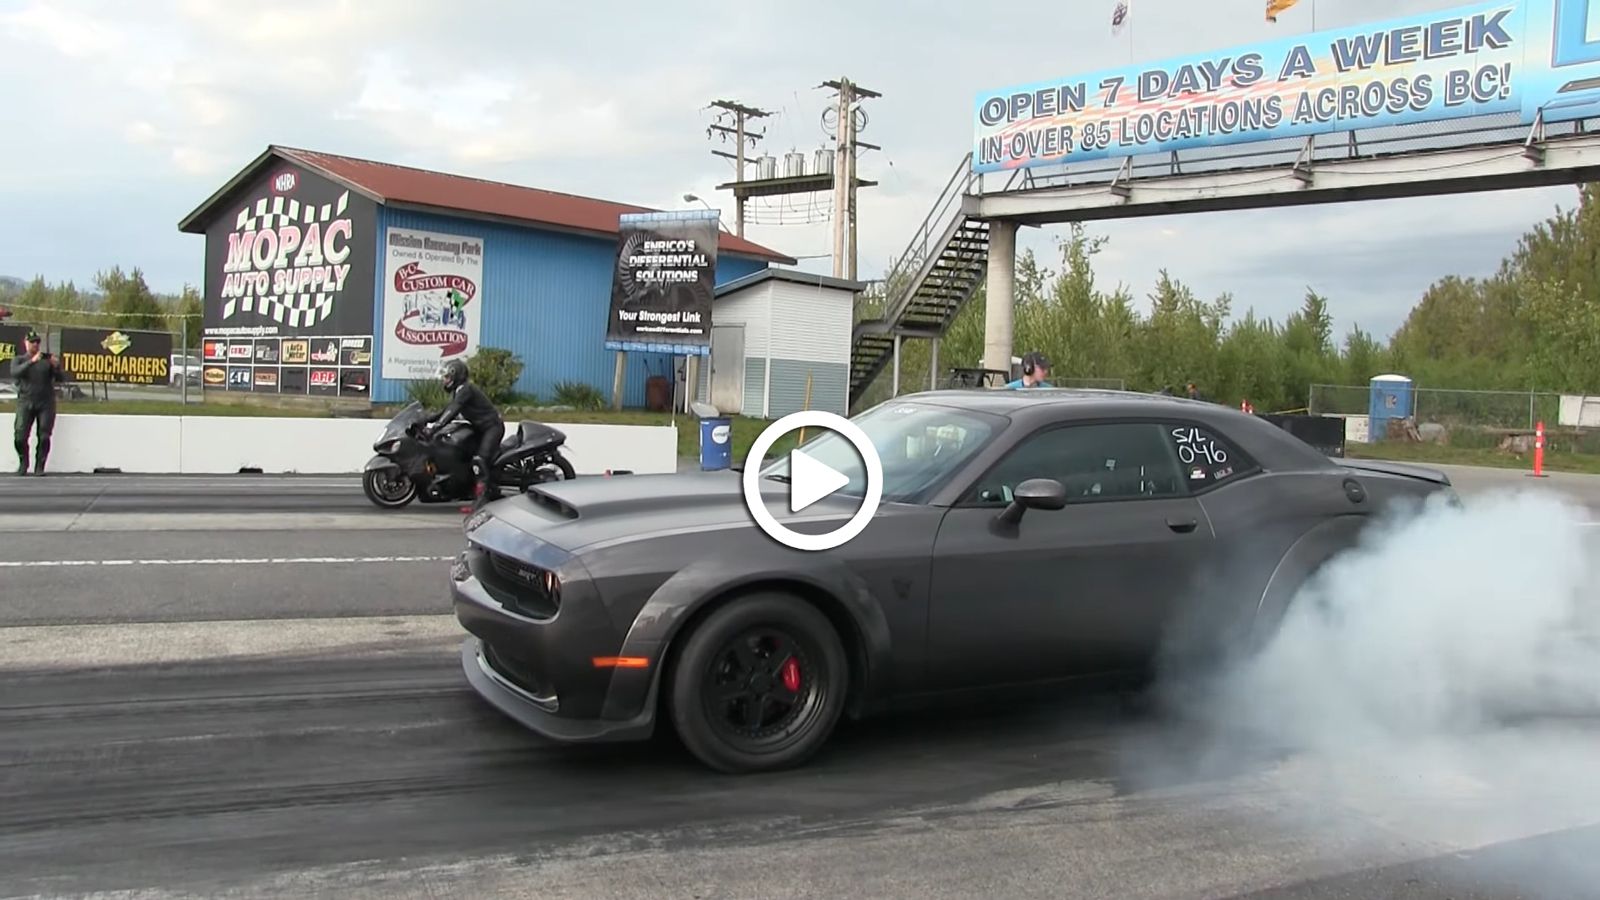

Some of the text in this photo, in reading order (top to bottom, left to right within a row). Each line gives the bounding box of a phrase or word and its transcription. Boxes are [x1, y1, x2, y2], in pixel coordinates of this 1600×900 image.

[980, 82, 1087, 127] OPEN
[1100, 76, 1125, 107] 7
[1138, 52, 1264, 102] DAYS
[1278, 45, 1316, 81] A
[1331, 9, 1514, 72] WEEK
[979, 62, 1512, 165] IN OVER 85 LOCATIONS ACROSS BC!
[275, 173, 295, 191] NHRA
[224, 218, 352, 273] MOPAC
[461, 241, 481, 255] Park
[644, 240, 695, 252] ENRICO'S
[392, 249, 478, 266] Owned & Operated By The
[629, 254, 708, 267] DIFFERENTIAL
[221, 264, 350, 298] AUTO SUPPLY
[635, 270, 698, 282] SOLUTIONS
[402, 277, 475, 296] CUSTOM CAR
[619, 309, 701, 324] Your Strongest Link
[397, 328, 467, 343] ASSOCIATION
[63, 353, 168, 377] TURBOCHARGERS
[76, 373, 117, 382] DIESEL
[129, 375, 153, 384] GAS
[311, 371, 337, 383] ARP
[1178, 440, 1227, 465] 046
